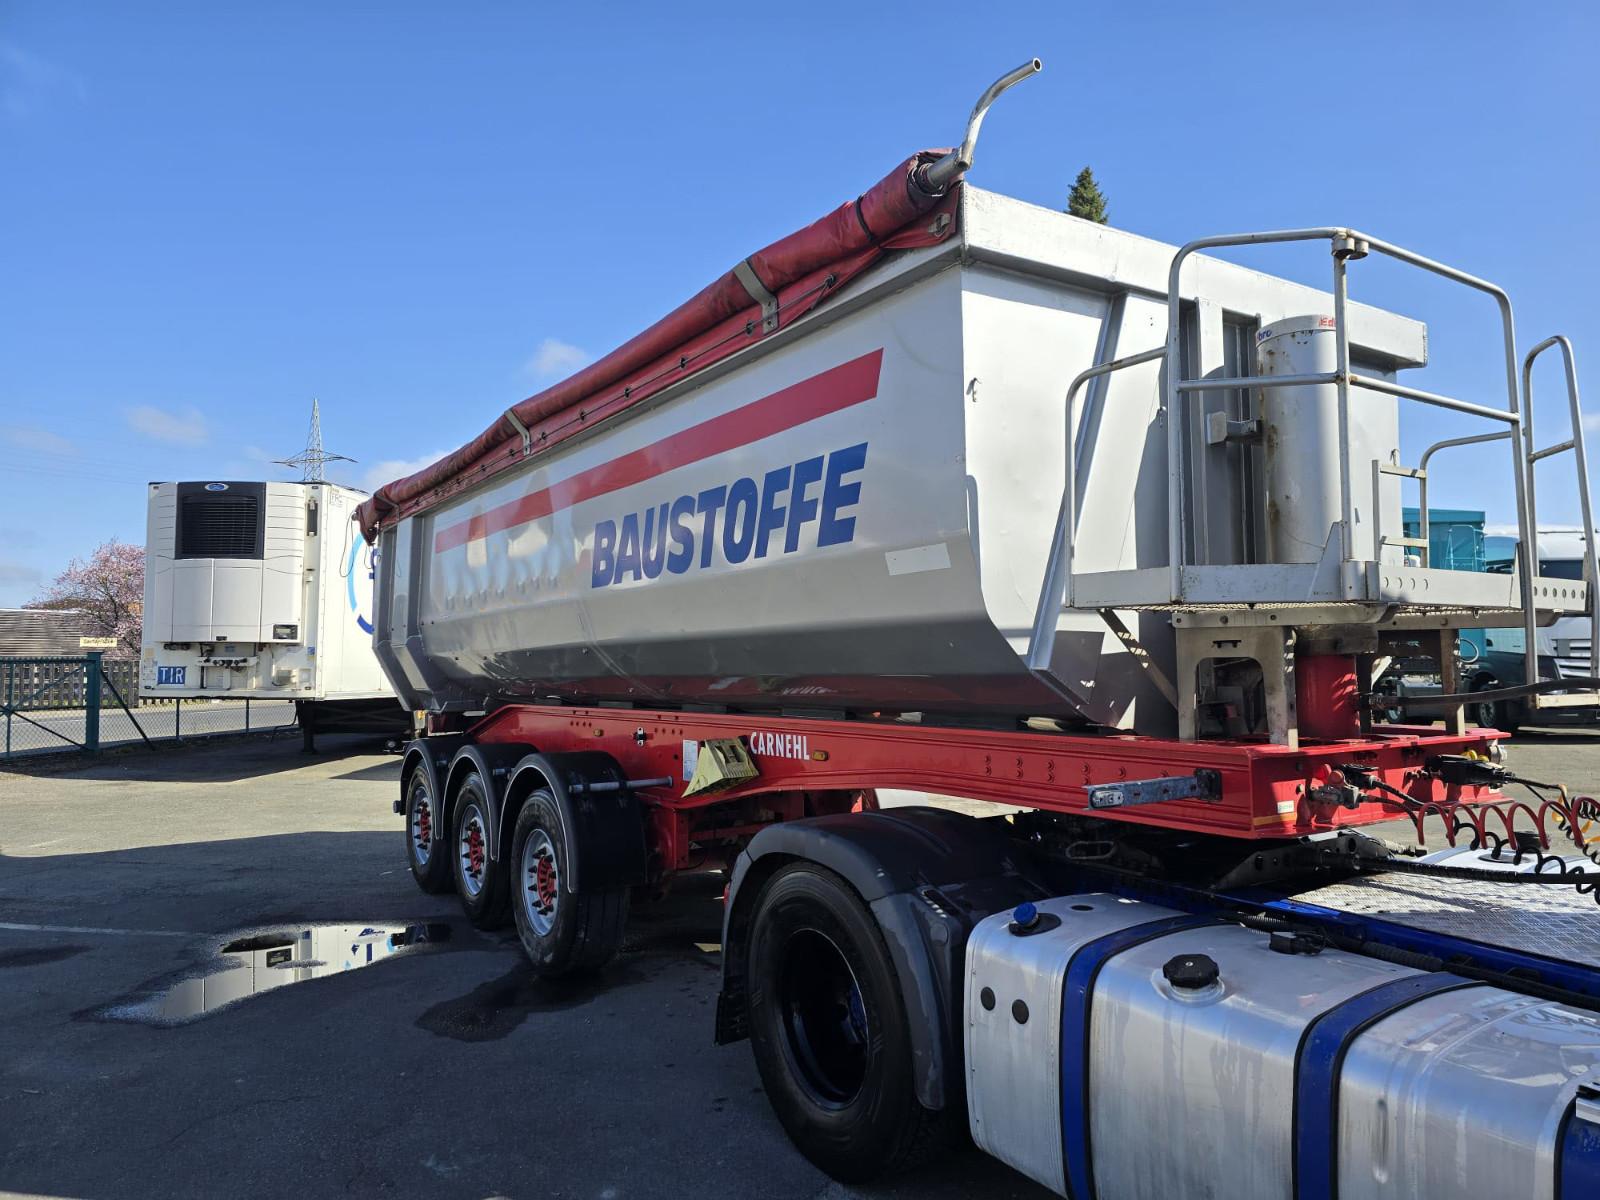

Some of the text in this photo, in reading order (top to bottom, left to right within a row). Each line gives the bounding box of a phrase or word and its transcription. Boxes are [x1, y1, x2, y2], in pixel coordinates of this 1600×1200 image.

[1319, 315, 1336, 327] Ed
[591, 441, 868, 589] BAUSTOFFE
[160, 667, 185, 684] TIR
[749, 731, 810, 761] CARNEHL
